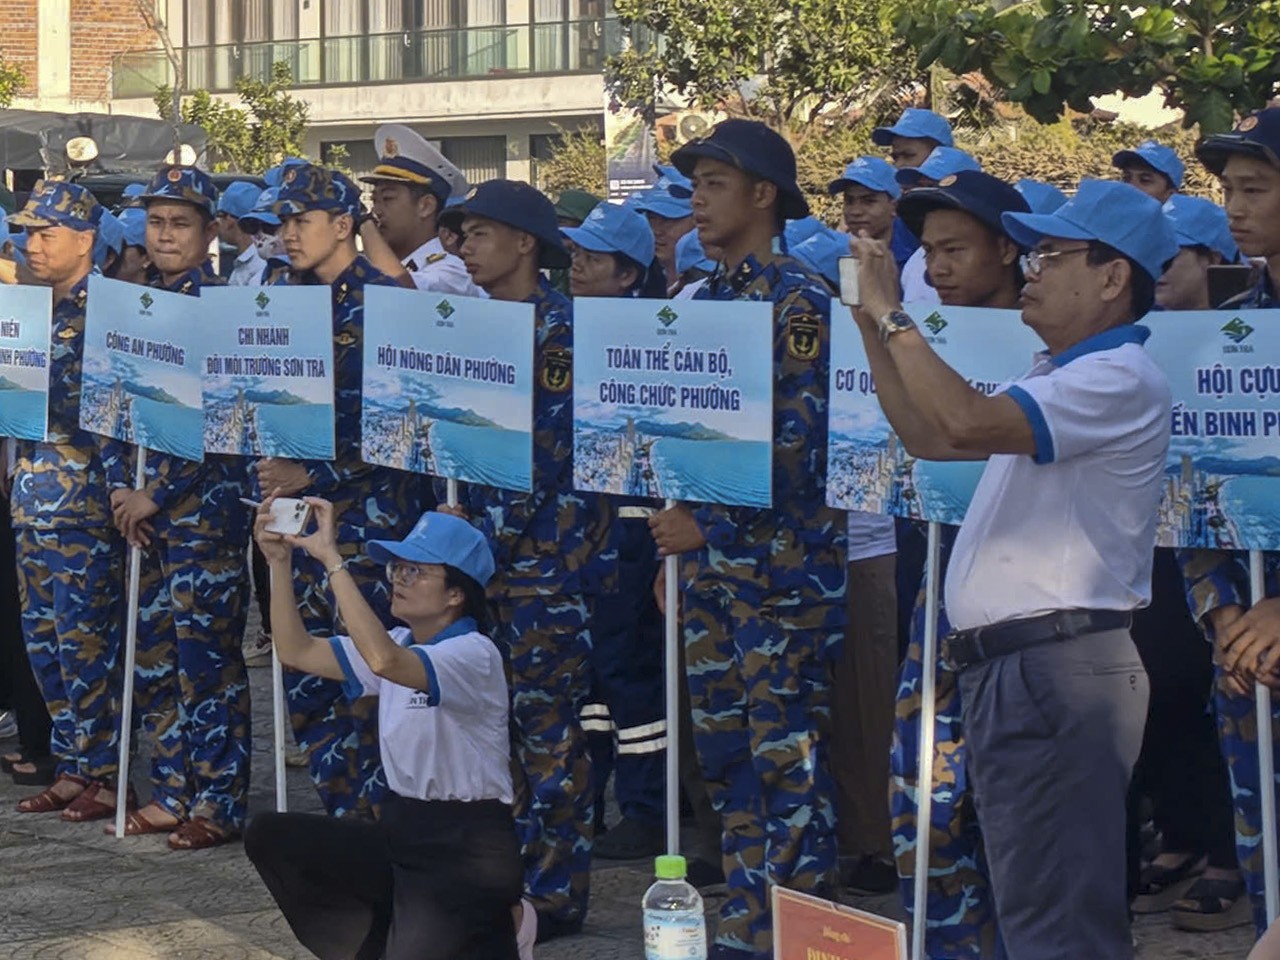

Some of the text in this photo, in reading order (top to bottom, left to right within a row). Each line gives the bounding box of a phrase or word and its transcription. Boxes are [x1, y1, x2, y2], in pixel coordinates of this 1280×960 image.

[106, 330, 185, 366] CÔNG AN PHƯỜNG
[245, 353, 281, 376] TRƯỜNG
[377, 344, 516, 385] HỘI NÔNG DÂN PHƯỜNG
[606, 341, 733, 379] TOÀN THỂ CÁN BỘ,
[599, 378, 741, 412] CÔNG CHỨC PHƯỜNG
[835, 367, 856, 392] CƠ
[1197, 363, 1233, 400] HỘI
[1205, 411, 1257, 437] BINH
